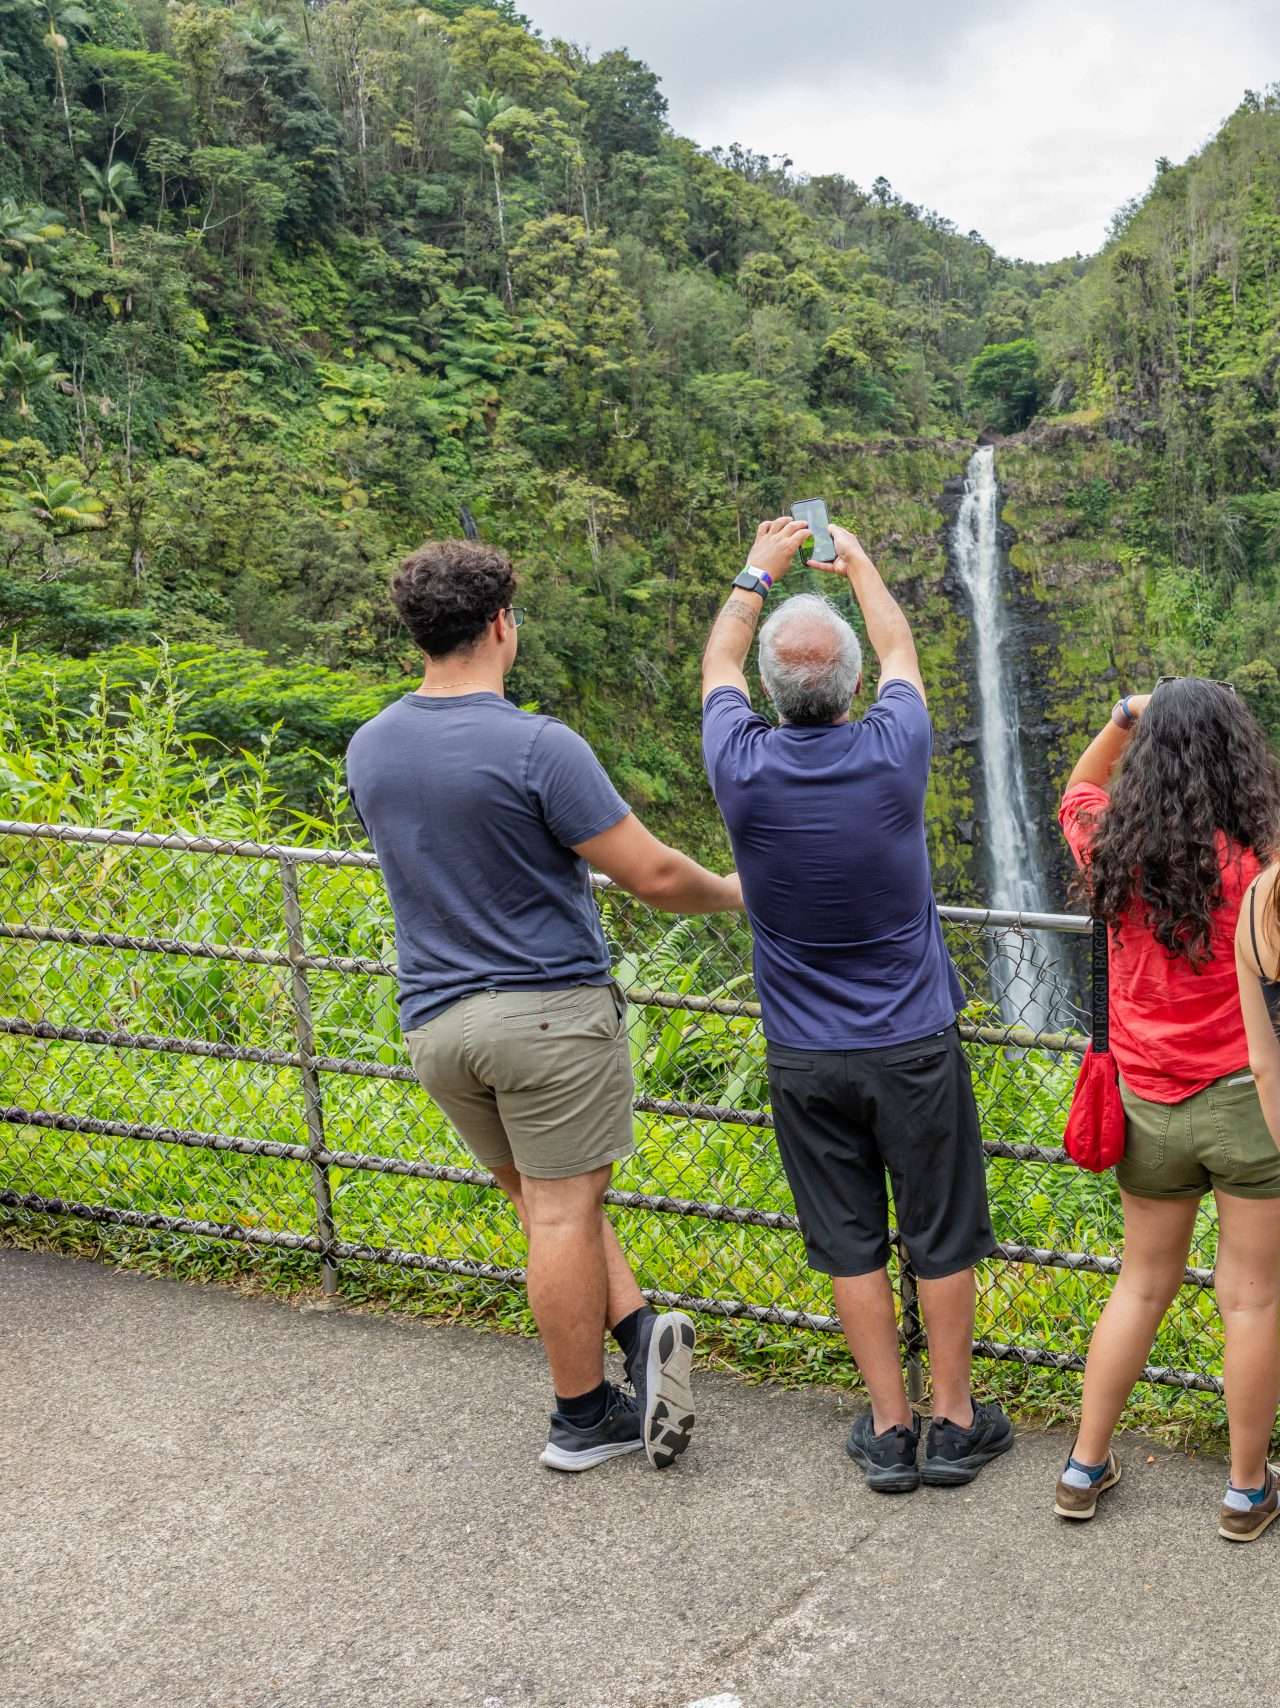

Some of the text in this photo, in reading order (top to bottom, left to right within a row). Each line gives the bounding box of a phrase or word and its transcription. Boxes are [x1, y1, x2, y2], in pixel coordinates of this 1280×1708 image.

[1094, 918, 1107, 1051] GU BAGGU BAGGU
